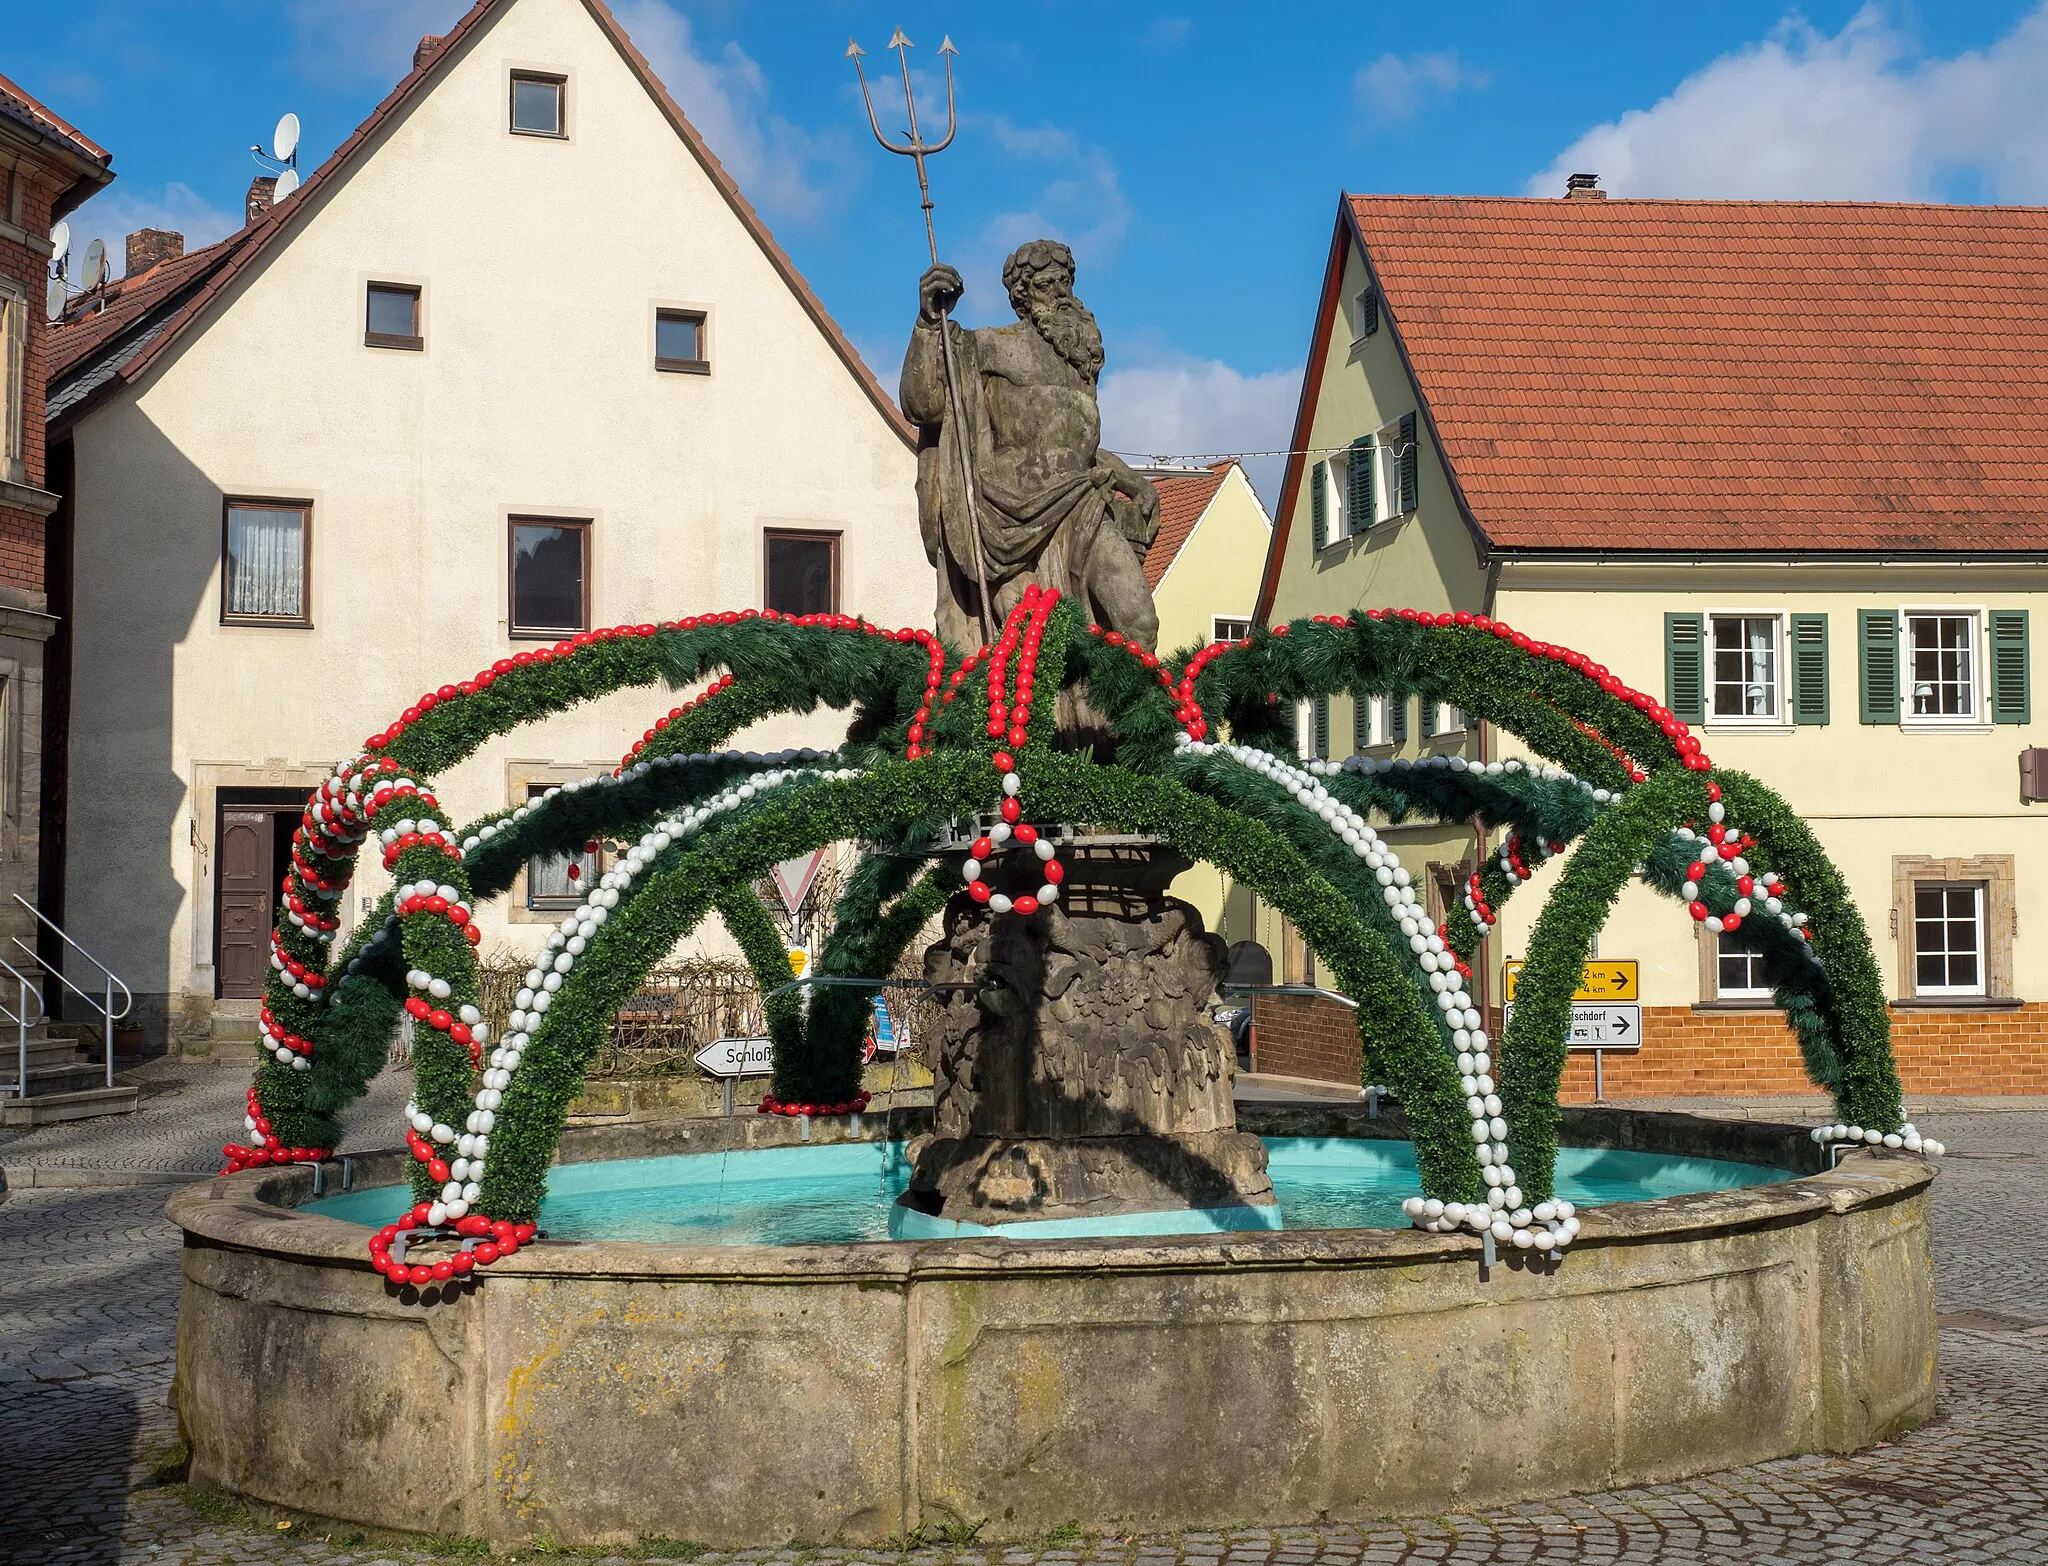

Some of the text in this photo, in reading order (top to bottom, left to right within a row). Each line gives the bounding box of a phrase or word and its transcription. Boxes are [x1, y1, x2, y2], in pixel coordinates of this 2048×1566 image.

[1592, 971, 1606, 979] km
[1583, 983, 1590, 993] 4
[1572, 1010, 1606, 1021] tschdorf
[726, 1047, 771, 1063] Schloß
